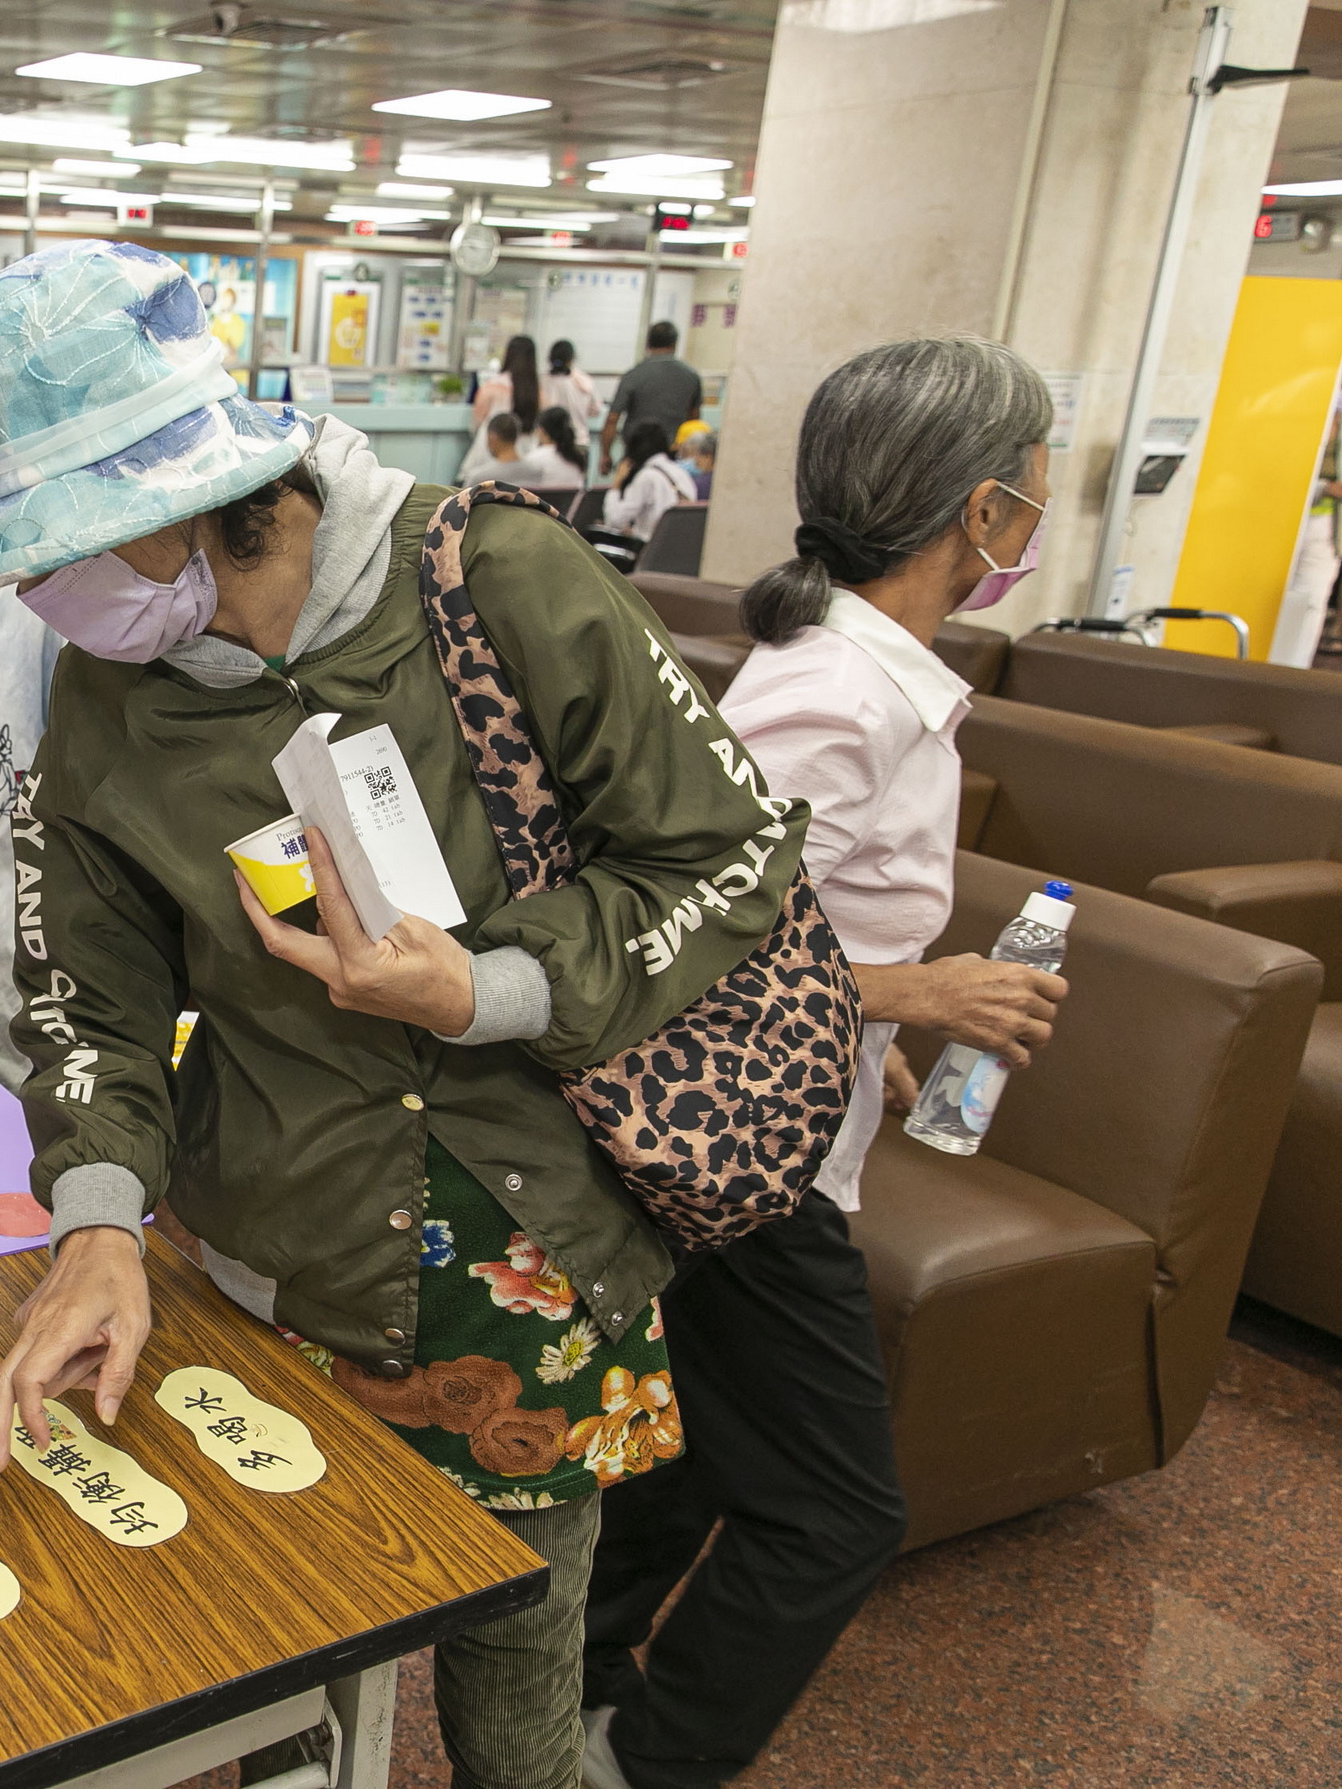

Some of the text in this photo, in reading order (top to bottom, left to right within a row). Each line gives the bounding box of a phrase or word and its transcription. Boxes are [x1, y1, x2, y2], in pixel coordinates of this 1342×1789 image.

[644, 628, 710, 724] TRY
[15, 859, 48, 960] AND
[183, 1387, 293, 1472] 多喝水
